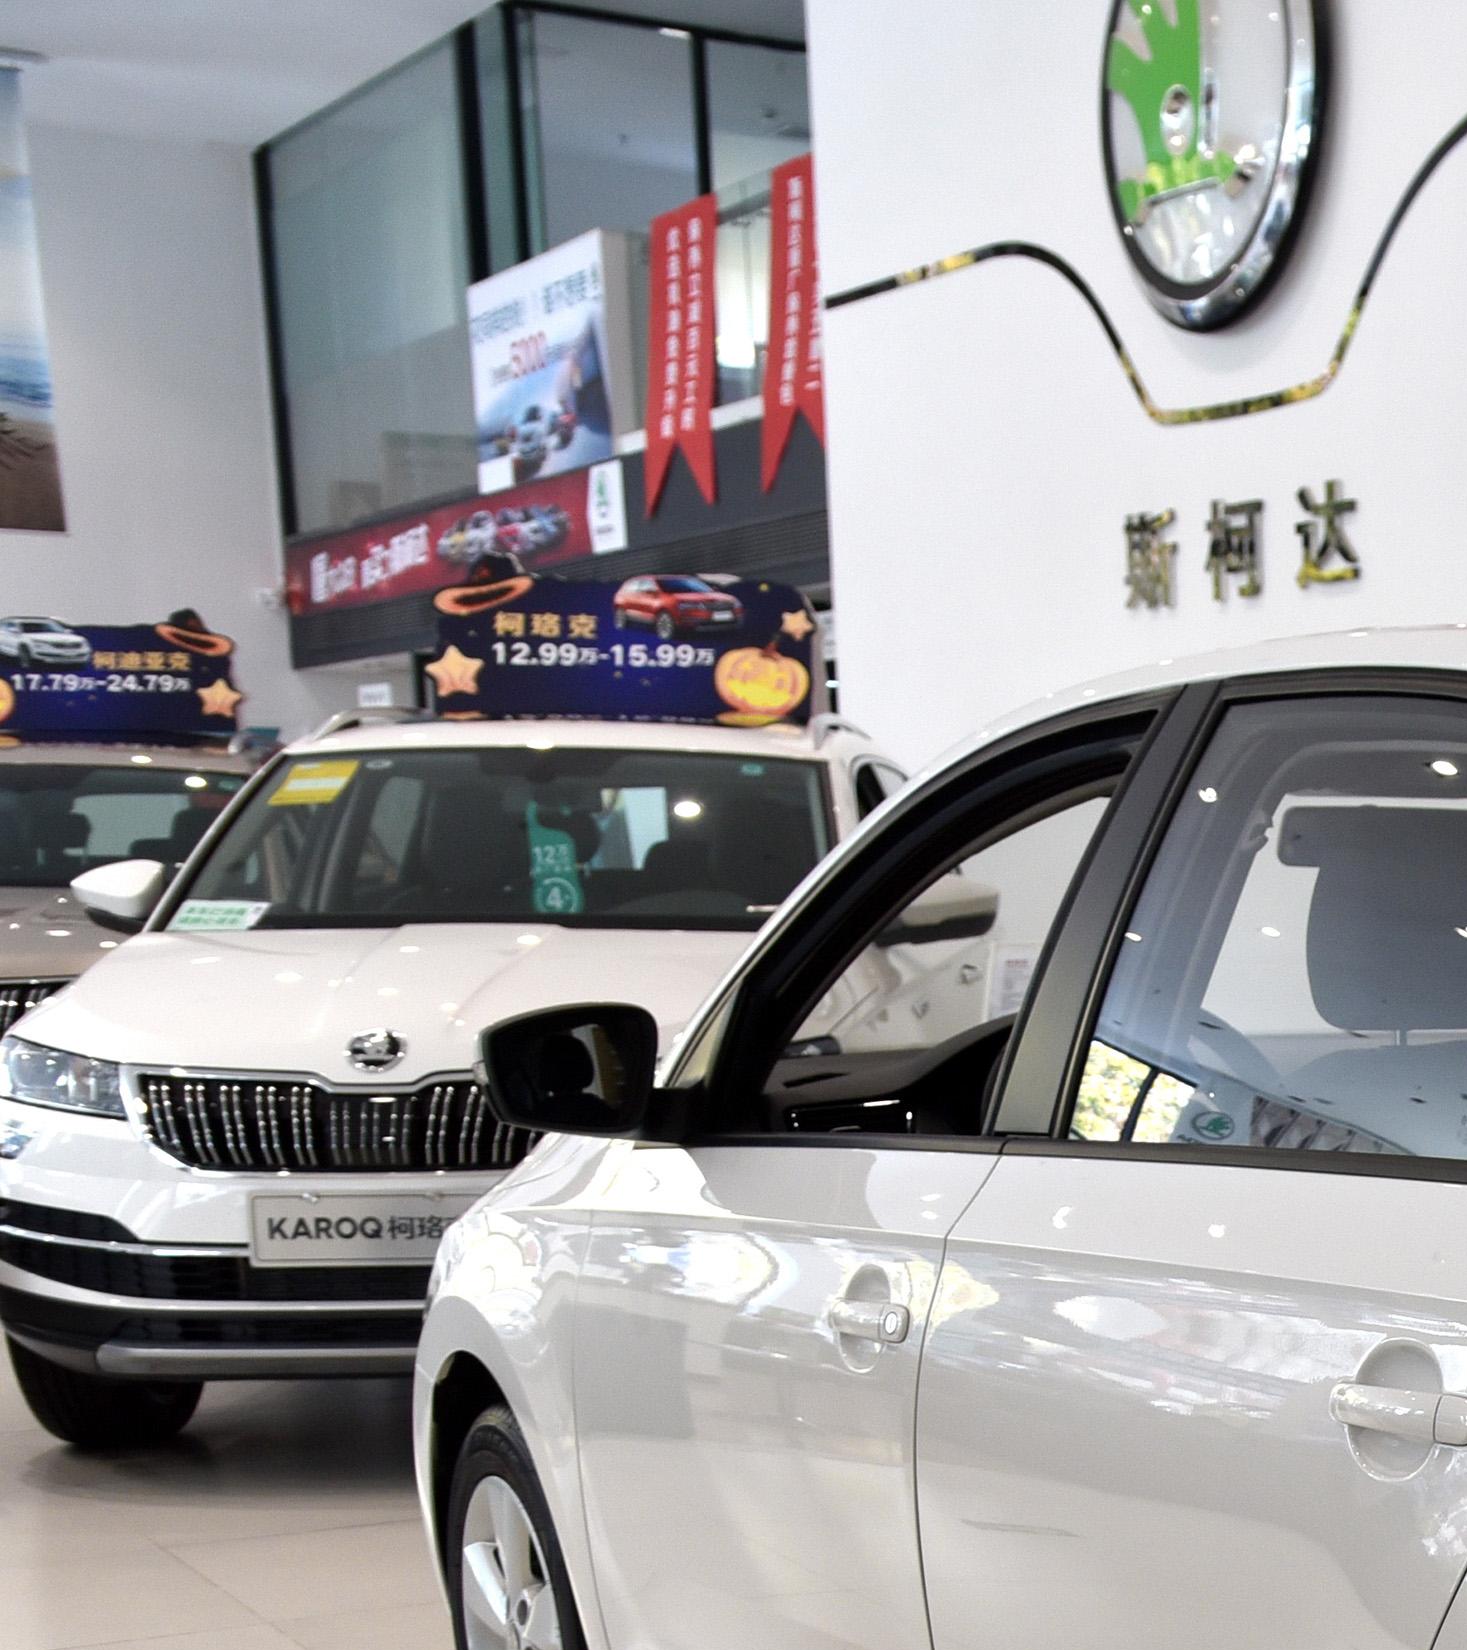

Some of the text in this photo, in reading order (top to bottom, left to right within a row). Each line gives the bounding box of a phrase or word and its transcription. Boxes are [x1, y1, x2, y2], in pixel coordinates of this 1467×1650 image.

[1125, 480, 1362, 609] 斯柯达
[493, 611, 598, 639] 柯珞克
[491, 641, 715, 667] 12.99万-15.99万
[267, 1215, 457, 1240] KAROQ 柯珞
